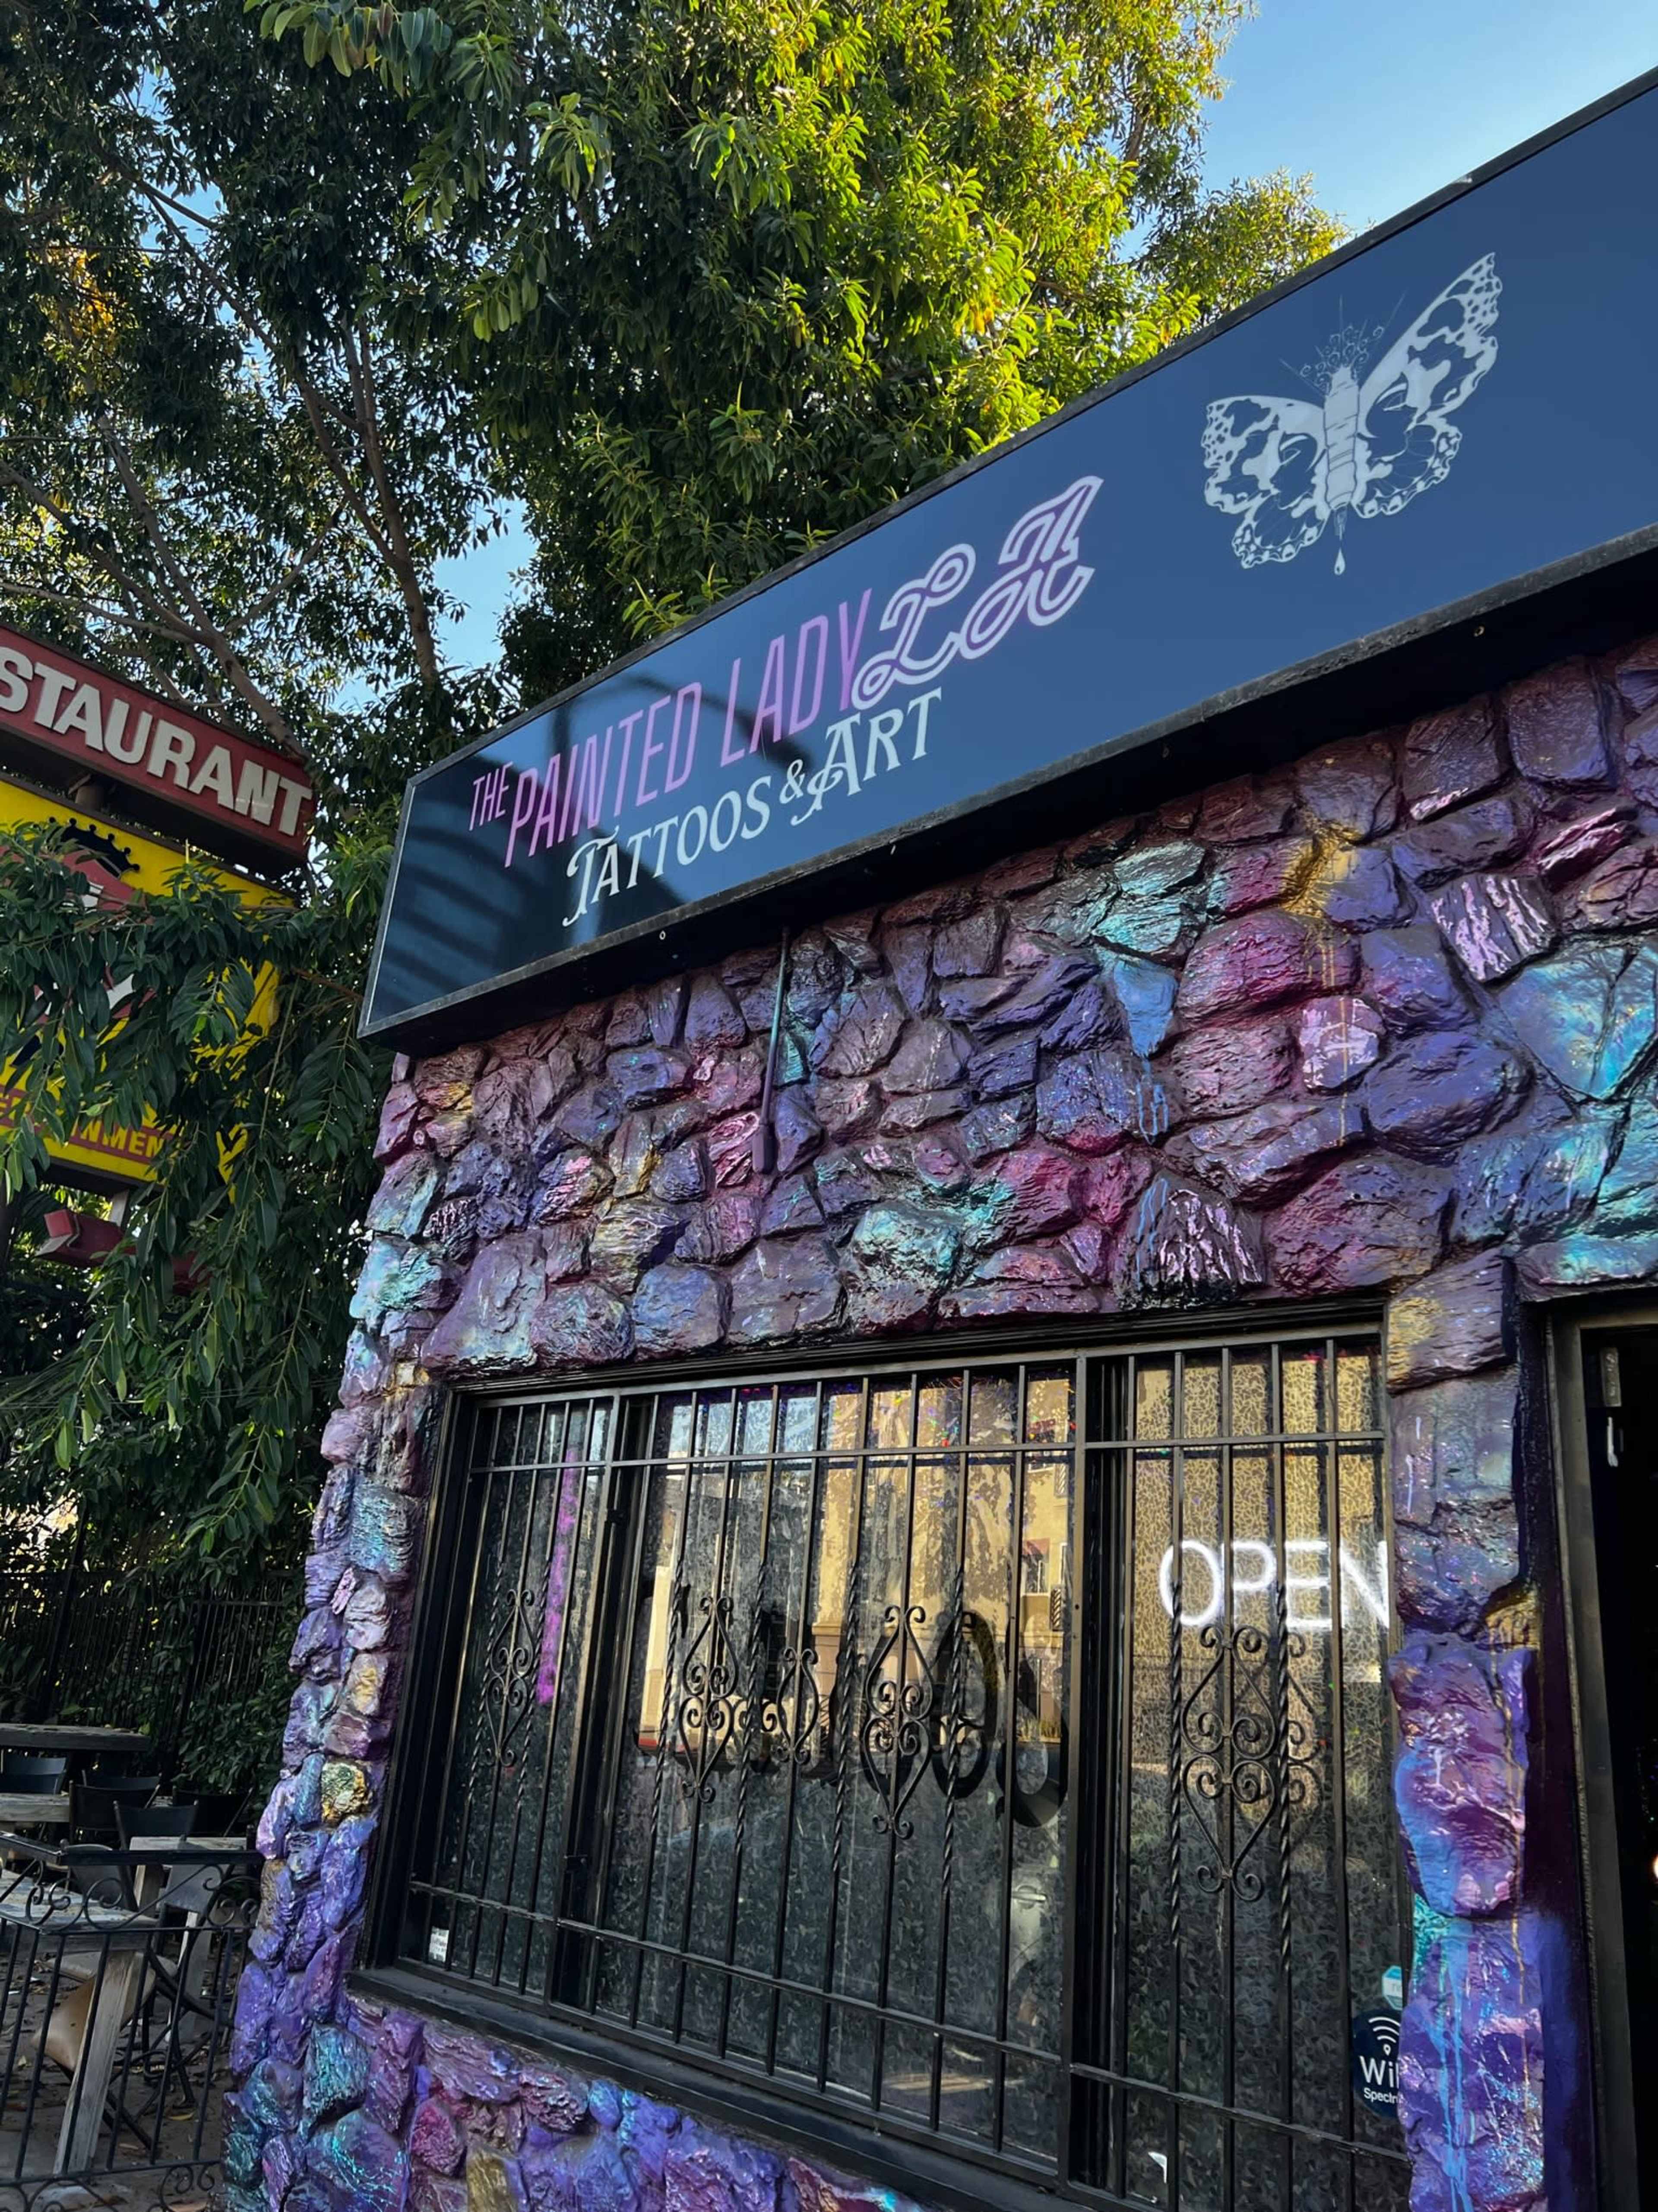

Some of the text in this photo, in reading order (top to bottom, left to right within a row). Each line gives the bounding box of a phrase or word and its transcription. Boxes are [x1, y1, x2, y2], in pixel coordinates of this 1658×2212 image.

[0, 646, 313, 837] STAURANT
[469, 588, 872, 868] THE PAINTED LADY
[562, 687, 942, 927] TATTOOS & ART
[1158, 1540, 1389, 1630] OPEN
[1359, 2056, 1399, 2089] Wi
